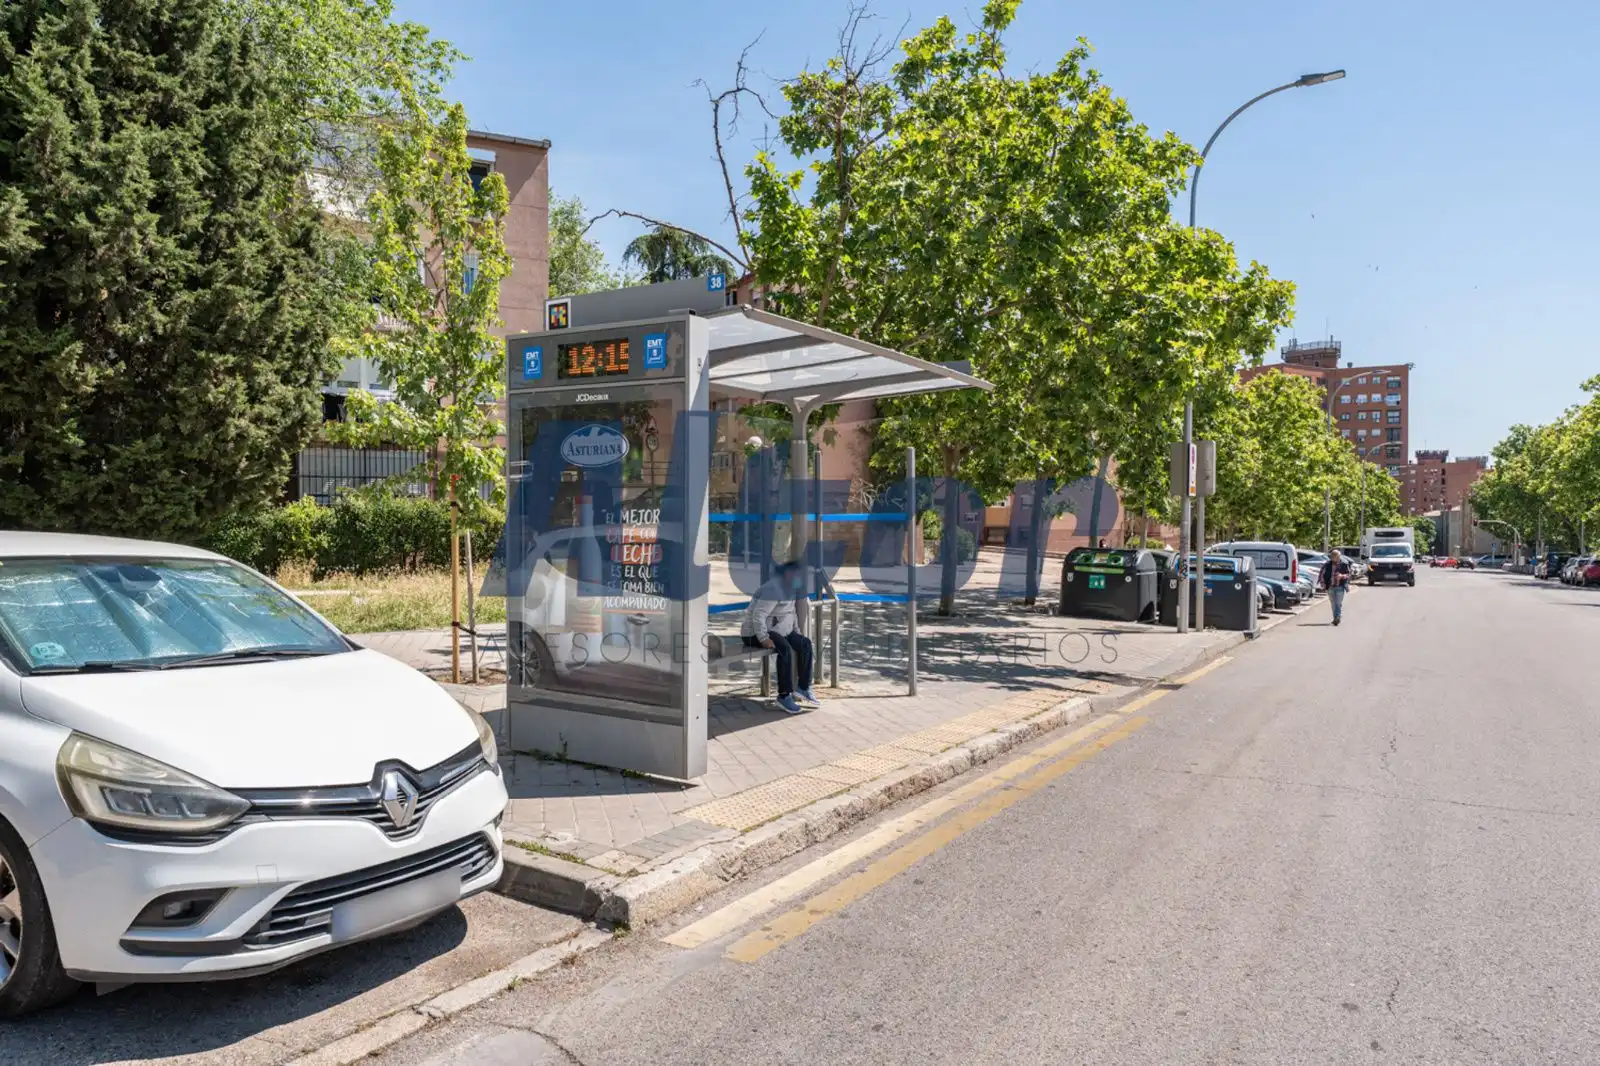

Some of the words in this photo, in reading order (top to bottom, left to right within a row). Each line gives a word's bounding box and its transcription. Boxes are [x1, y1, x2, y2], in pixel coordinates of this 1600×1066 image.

[710, 276, 721, 289] 38
[647, 339, 662, 348] EMT
[525, 351, 539, 360] EMT
[621, 509, 660, 526] MEJOR
[613, 543, 661, 565] LECHE
[624, 565, 635, 578] EL
[638, 565, 658, 582] QUE
[603, 595, 667, 610] ACOMPAÑADO
